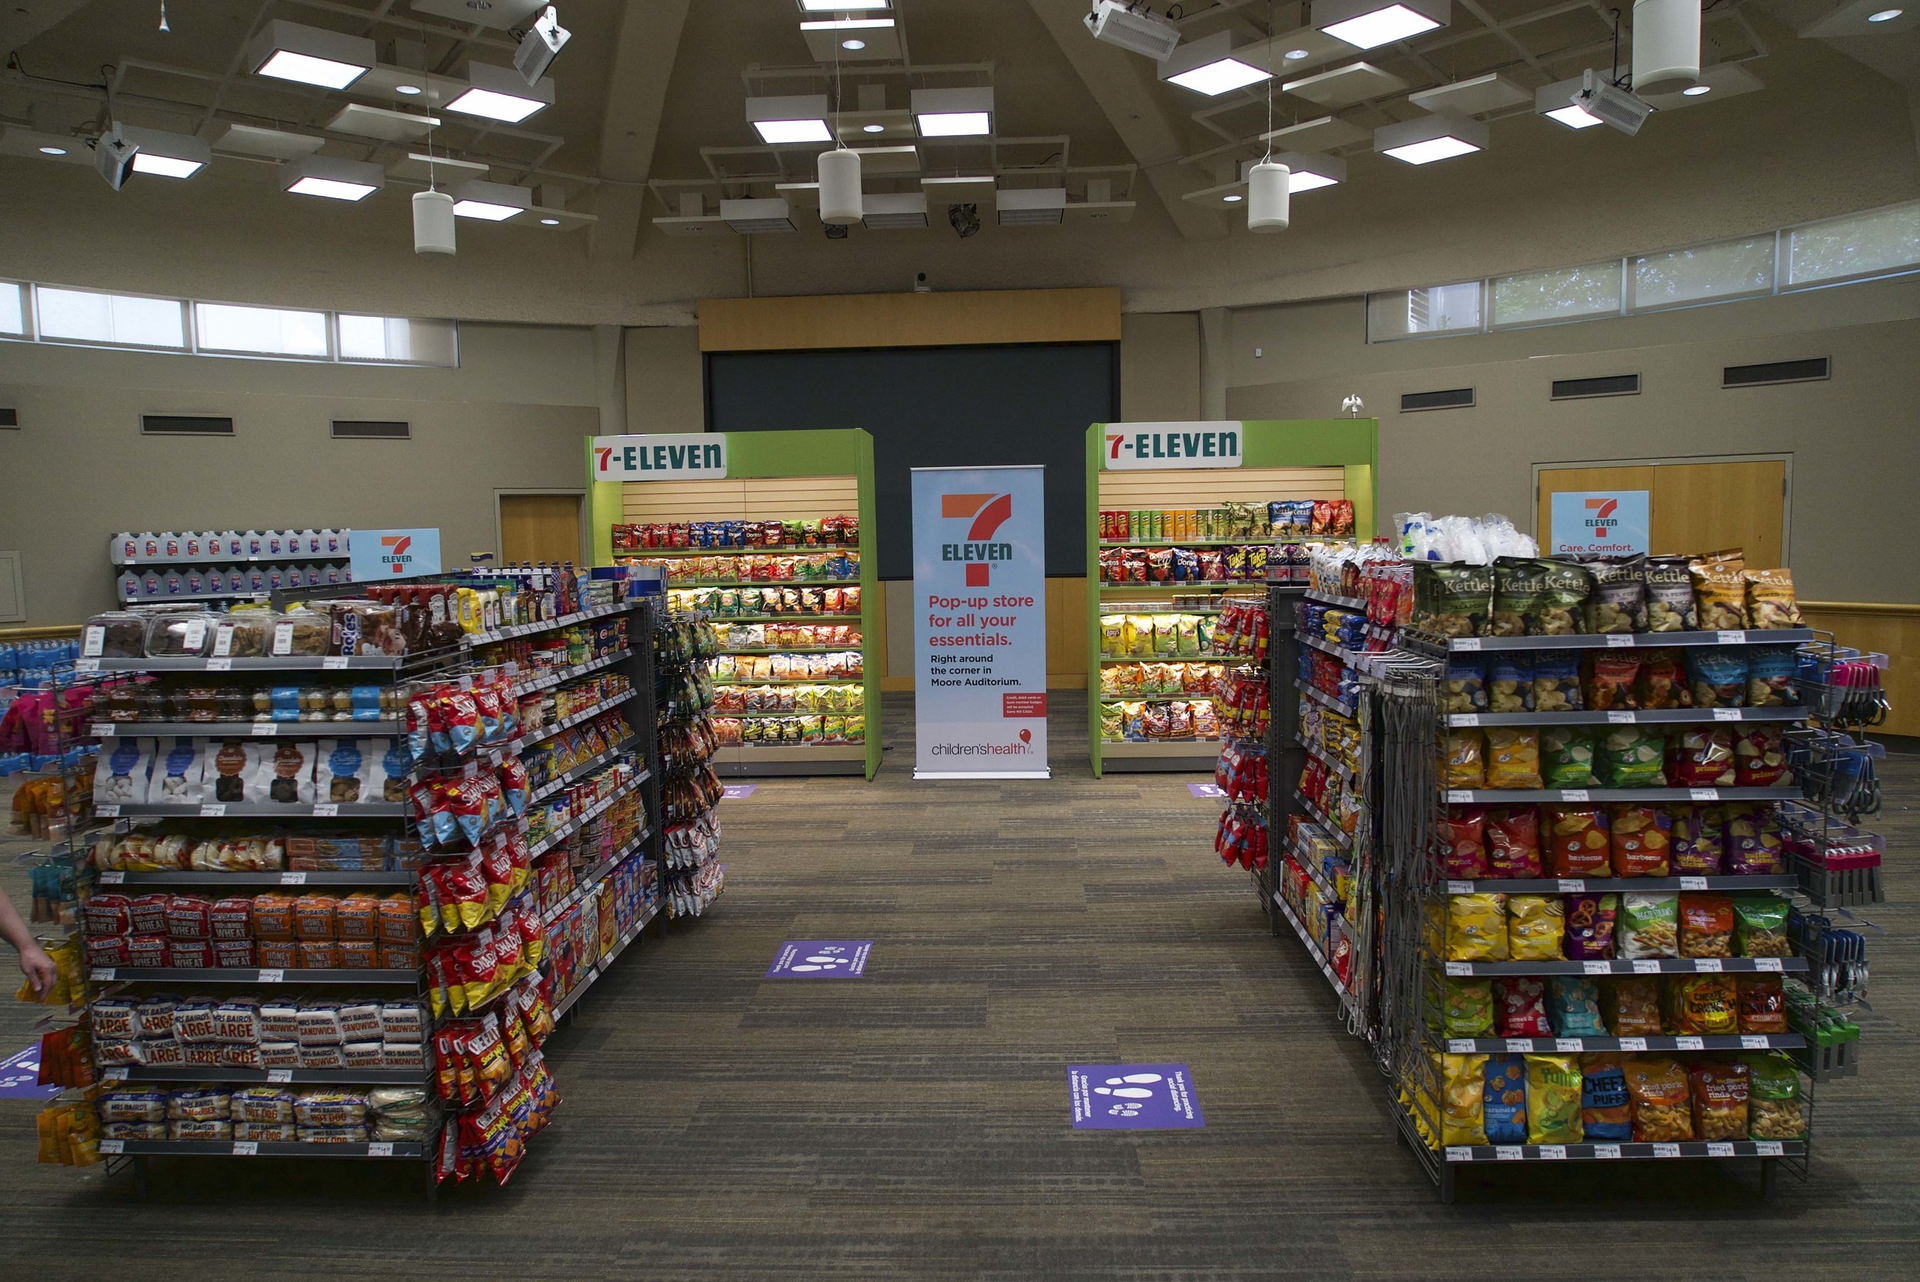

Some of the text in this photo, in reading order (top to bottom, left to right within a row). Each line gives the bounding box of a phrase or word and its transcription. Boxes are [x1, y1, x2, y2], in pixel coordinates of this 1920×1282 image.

[1559, 543, 1634, 552] Care. Comfort.
[1596, 567, 1643, 584] Kettle
[1646, 569, 1690, 584] Kettle
[1704, 569, 1746, 585] Kettle
[1445, 578, 1490, 595] Kettle
[1500, 578, 1545, 593] Kettle
[1544, 575, 1590, 595] Kettle
[929, 594, 1034, 610] Pop-up store
[929, 613, 1017, 629] for all your
[929, 632, 1012, 646] essentials.
[930, 654, 993, 664] Right around
[931, 666, 946, 675] the
[983, 666, 992, 674] in
[931, 677, 1022, 686] Moore Auditorium.
[136, 919, 166, 931] WHEAT
[258, 916, 283, 925] HONEY
[302, 918, 326, 927] HONEY
[343, 919, 367, 928] HONEY
[385, 921, 410, 930] HONEY
[91, 922, 118, 932] WHEAT
[170, 925, 200, 937] WHEAT
[215, 928, 246, 939] WHEAT
[266, 951, 291, 960] HONEY
[306, 952, 331, 960] HONEY
[345, 951, 369, 961] HONEY
[389, 952, 413, 961] HONEY
[134, 957, 162, 968] WHEAT
[174, 957, 204, 968] WHEAT
[221, 957, 252, 967] WHEAT
[353, 1013, 375, 1021] BAIRD'S
[94, 1019, 131, 1033] LARGE
[215, 1023, 254, 1038] LARGE
[261, 1024, 298, 1032] SANDWICH
[300, 1026, 336, 1035] SANDWICH
[341, 1020, 379, 1032] SANDWICH
[384, 1024, 420, 1032] SANDWICH
[145, 1048, 184, 1064] LARGE
[184, 1050, 223, 1064] LARGE
[221, 1049, 260, 1064] LARGE
[347, 1058, 382, 1067] SANDWICH
[385, 1058, 423, 1067] SANDWICH
[1167, 1077, 1178, 1090] social
[1661, 1081, 1683, 1092] pork
[1707, 1083, 1748, 1093] fried pork
[1174, 1071, 1184, 1083] Thank
[1182, 1097, 1194, 1119] practicing
[1593, 1093, 1631, 1105] PUFFS
[1708, 1090, 1730, 1099] rinds
[244, 1107, 278, 1120] HOT DOG
[310, 1113, 347, 1122] HOT DOG
[248, 1131, 282, 1141] HOT DOG
